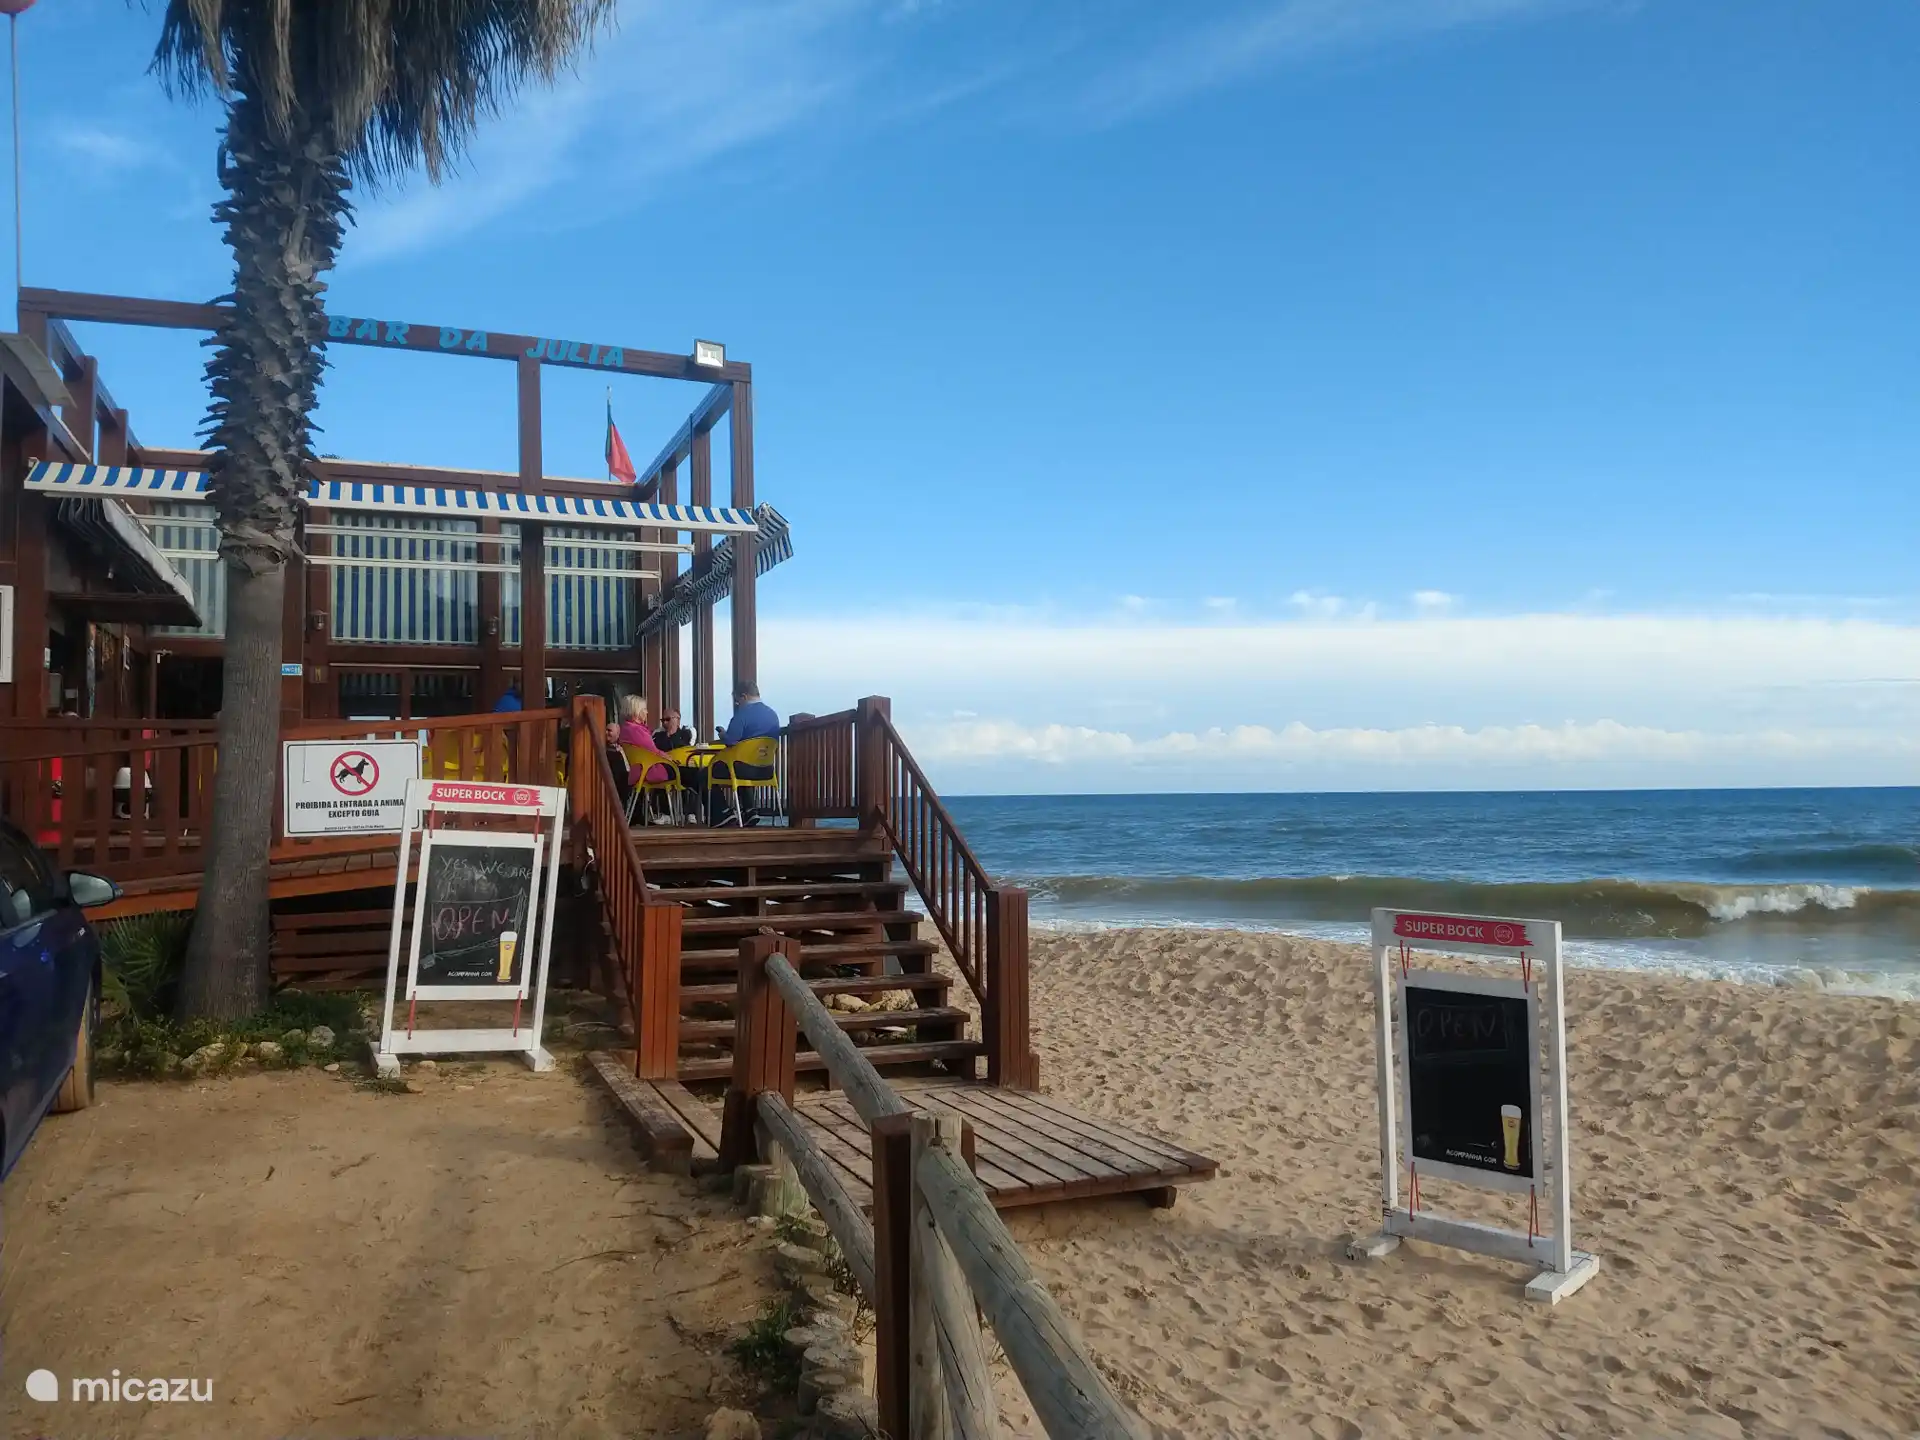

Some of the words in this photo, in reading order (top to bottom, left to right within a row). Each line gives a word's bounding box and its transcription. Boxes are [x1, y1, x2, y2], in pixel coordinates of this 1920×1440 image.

[328, 315, 409, 345] BAR
[439, 327, 488, 351] DA
[525, 337, 624, 367] JULIA
[436, 787, 473, 799] SUPER
[474, 789, 506, 801] BOCK
[296, 801, 332, 810] PROIBIDA
[340, 799, 373, 808] ENTRADA
[374, 799, 379, 807] A
[380, 798, 405, 807] ANIMA
[328, 810, 360, 818] EXCEPTO
[362, 809, 380, 817] GUIA
[434, 906, 510, 941] OPEN
[1405, 920, 1445, 935] SUPER
[1447, 924, 1484, 938] BOCK
